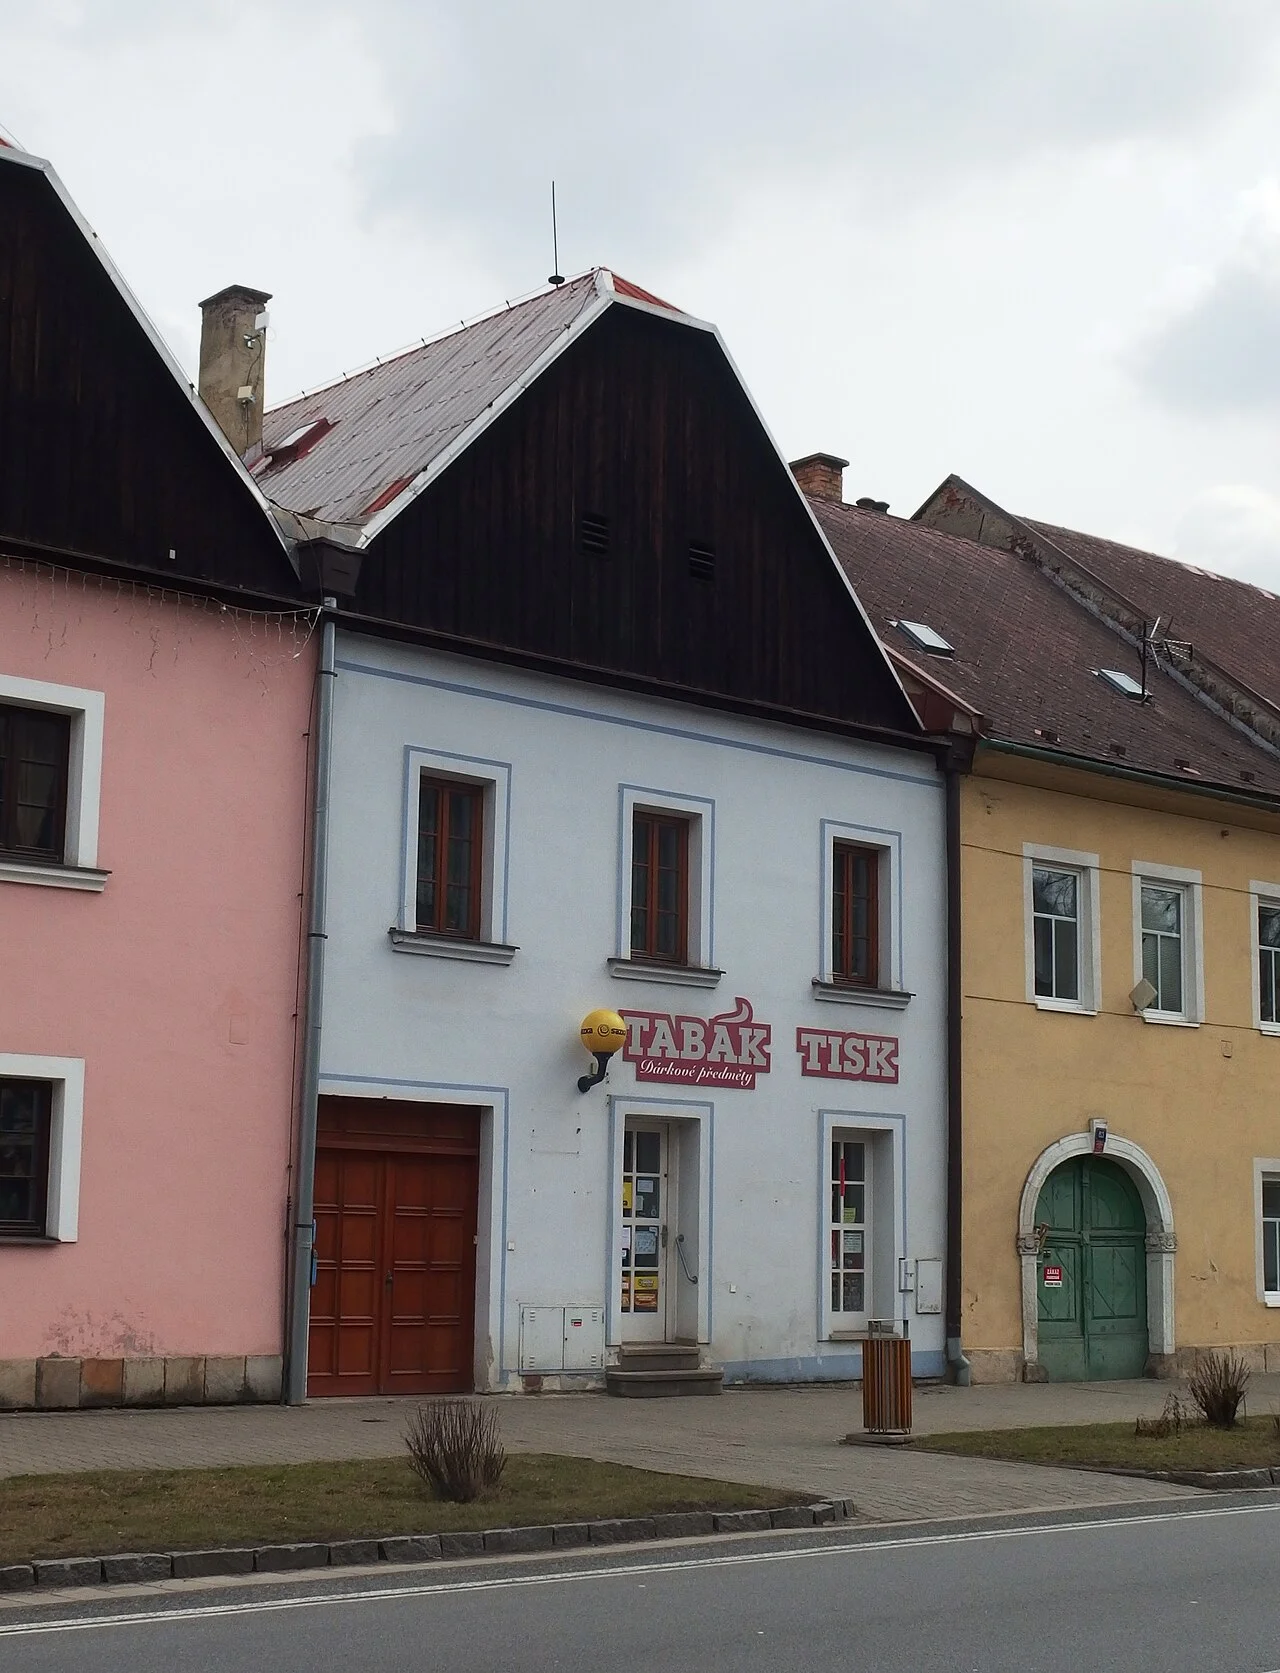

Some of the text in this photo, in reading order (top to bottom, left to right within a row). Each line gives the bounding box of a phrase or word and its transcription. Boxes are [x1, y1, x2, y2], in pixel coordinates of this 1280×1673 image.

[639, 1058, 753, 1086] Dárkové předměty
[801, 1033, 896, 1077] TISK
